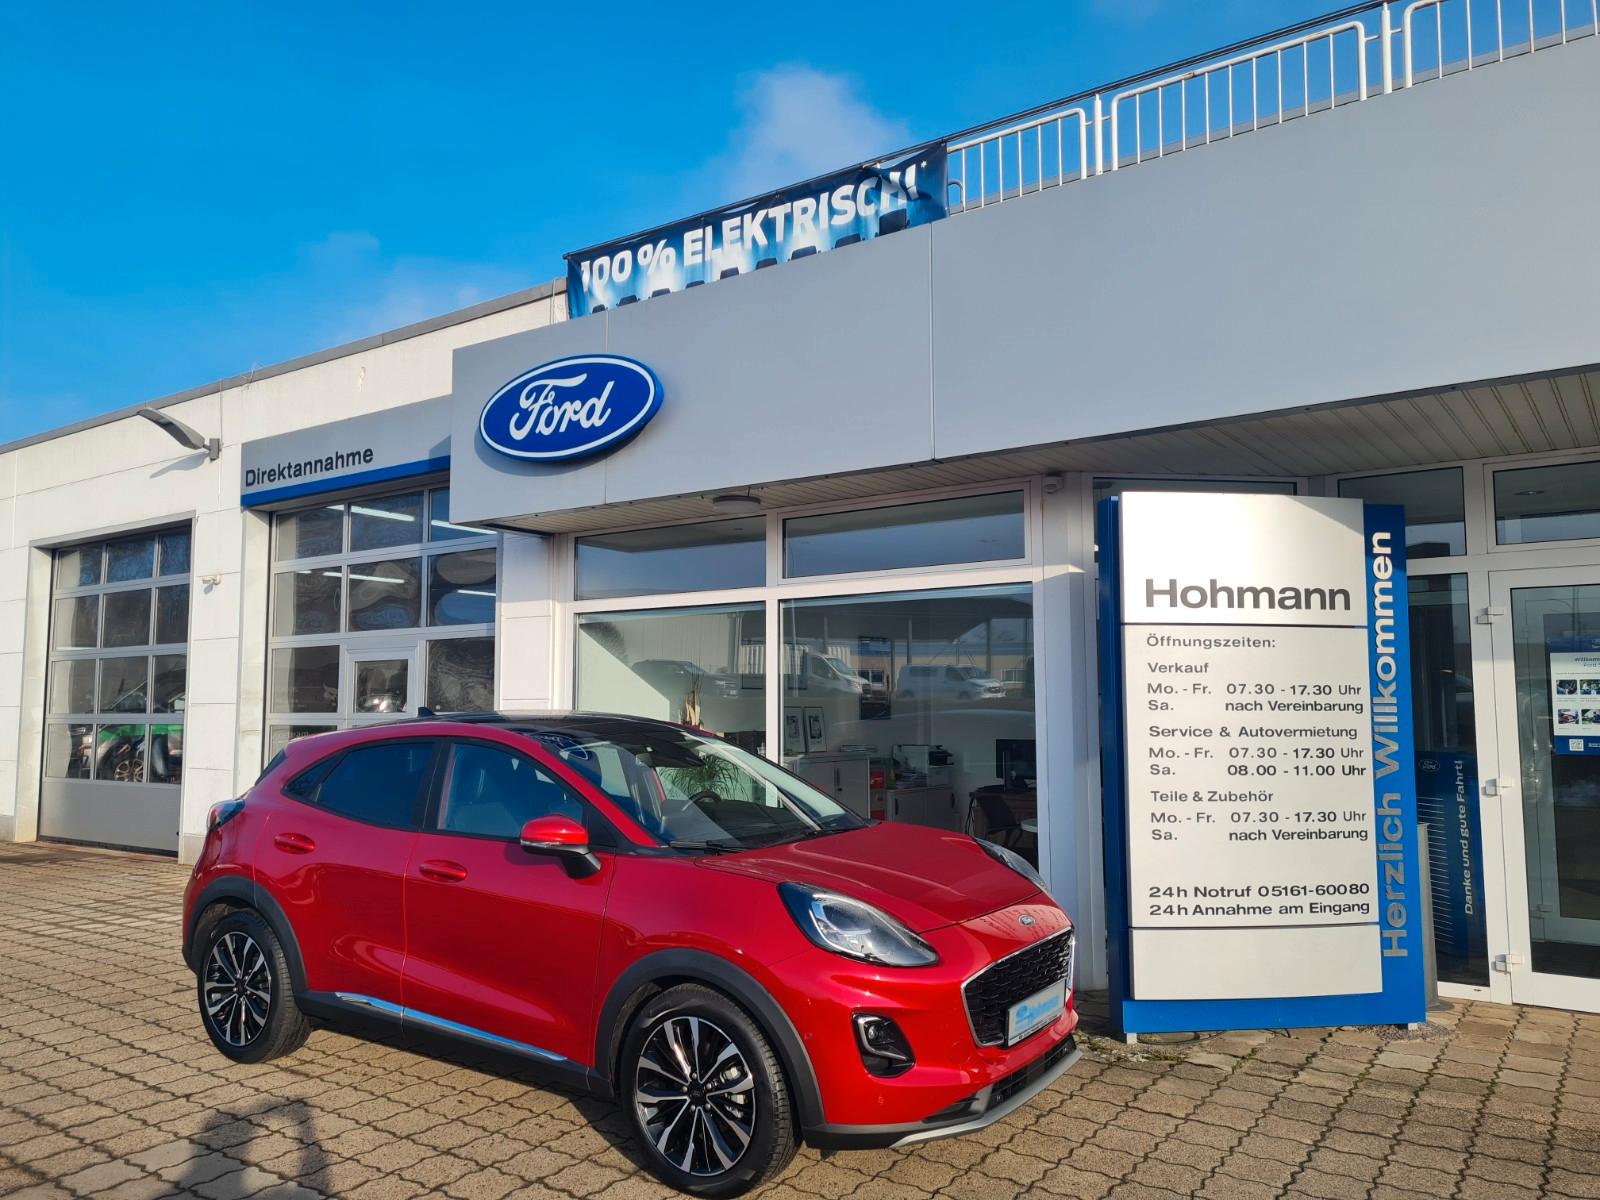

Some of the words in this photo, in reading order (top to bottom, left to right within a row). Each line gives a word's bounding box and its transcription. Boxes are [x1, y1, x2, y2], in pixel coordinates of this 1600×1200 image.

[580, 250, 632, 295] 100
[637, 238, 676, 276] %
[509, 373, 616, 441] Ford
[245, 446, 374, 488] Direktannahme
[1145, 578, 1351, 610] Hohmann
[1146, 634, 1276, 649] Öffnungszeiten:
[1371, 531, 1400, 779] Willkommen
[1148, 662, 1209, 673] Verkauf
[1147, 683, 1178, 695] Mo.
[1192, 683, 1211, 695] Fr.
[1226, 683, 1275, 695] 07.30
[1290, 685, 1332, 696] 17.30
[1338, 685, 1361, 695] Uhr
[1148, 700, 1173, 711] Sa.
[1225, 701, 1263, 712] nach
[1268, 701, 1363, 714] Vereinbarung
[1149, 726, 1212, 737] Service
[1220, 726, 1231, 737] &
[1238, 726, 1358, 739] Autovermietung
[1149, 748, 1180, 759] Mo.
[1194, 748, 1213, 759] Fr.
[1229, 748, 1277, 759] 07.30
[1293, 748, 1335, 759] 17.30
[1340, 748, 1363, 758] Uhr
[1150, 764, 1175, 775] Sa.
[1228, 765, 1276, 776] 08.00
[1293, 765, 1335, 776] 11.00
[1342, 765, 1366, 776] Uhr
[1454, 760, 1465, 802] Fahrt!
[1151, 791, 1188, 802] Teile
[1192, 791, 1203, 802] &
[1208, 791, 1273, 802] Zubehör
[1151, 812, 1181, 823] Mo.
[1196, 812, 1216, 823] Fr.
[1231, 812, 1279, 823] 07.30
[1294, 812, 1336, 823] 17.30
[1343, 811, 1366, 822] Uhr
[1458, 805, 1469, 837] gute
[1152, 829, 1177, 841] Sa.
[1229, 830, 1267, 841] nach
[1272, 829, 1368, 841] Vereinbarung
[1460, 840, 1469, 867] und
[1377, 792, 1408, 957] Herzlich
[1149, 886, 1188, 898] 24h
[1194, 886, 1251, 898] Notruf
[1258, 883, 1369, 897] 05161-60080
[1462, 869, 1473, 914] Danke
[1149, 904, 1188, 916] 24h
[1193, 904, 1272, 916] Annahme
[1279, 906, 1303, 915] am
[1309, 902, 1369, 915] Eingang
